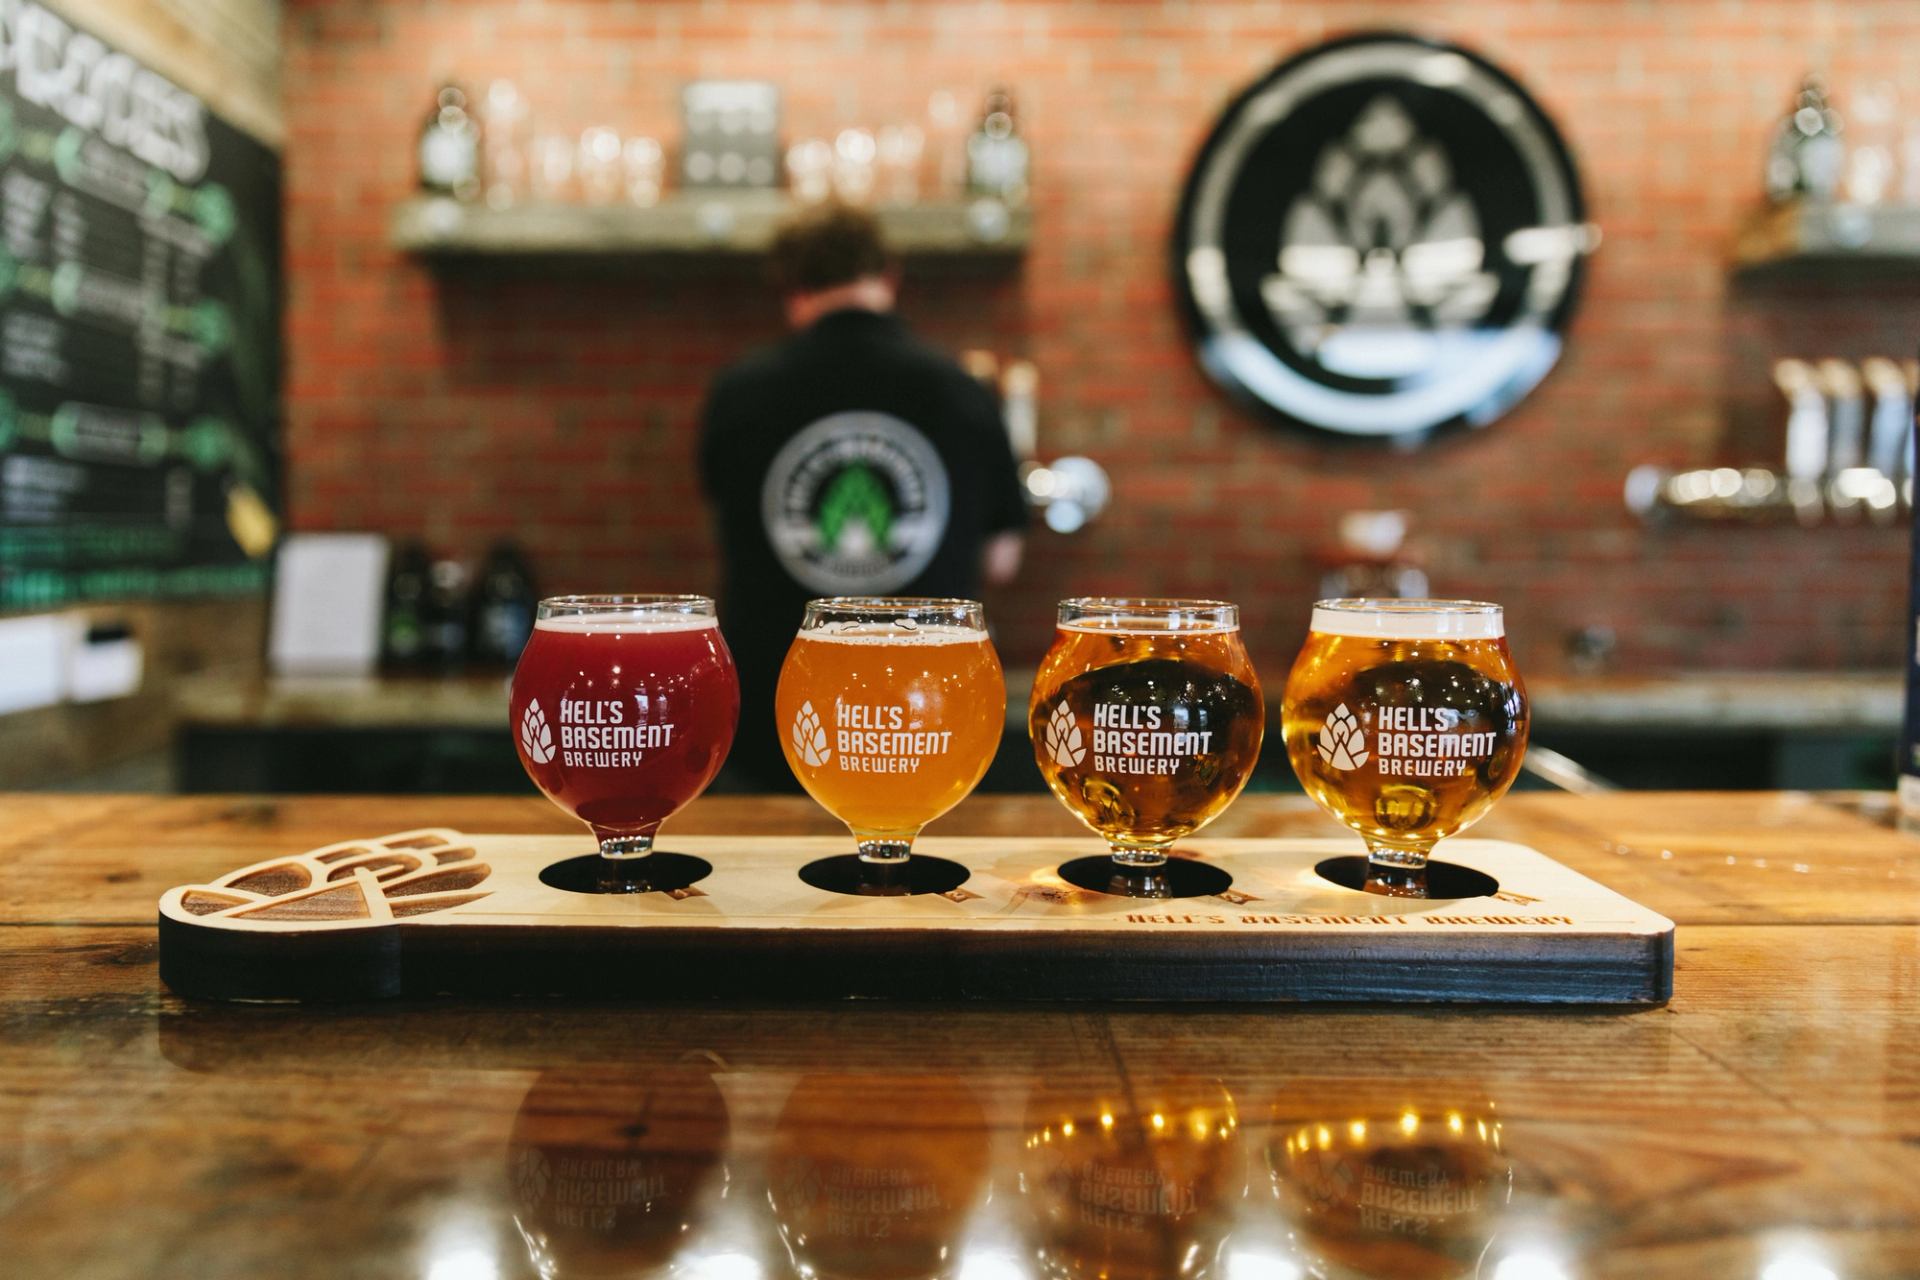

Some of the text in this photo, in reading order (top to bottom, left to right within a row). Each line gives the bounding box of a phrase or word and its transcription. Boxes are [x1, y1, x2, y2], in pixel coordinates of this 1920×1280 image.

[560, 700, 623, 724] HELL'S
[837, 704, 903, 730] HELL'S
[1093, 703, 1161, 730] HELL'S
[1378, 706, 1449, 732] HELL'S
[561, 724, 674, 749] BASEMENT
[837, 730, 952, 755] BASEMENT
[1093, 729, 1213, 756] BASEMENT
[1378, 732, 1497, 758] BASEMENT
[563, 751, 642, 767] BREWERY
[839, 755, 920, 773] BREWERY
[1094, 756, 1180, 775] BREWERY
[1378, 758, 1467, 777] BREWERY
[1126, 914, 1573, 926] HELL'S BASEMENT BREWERY
